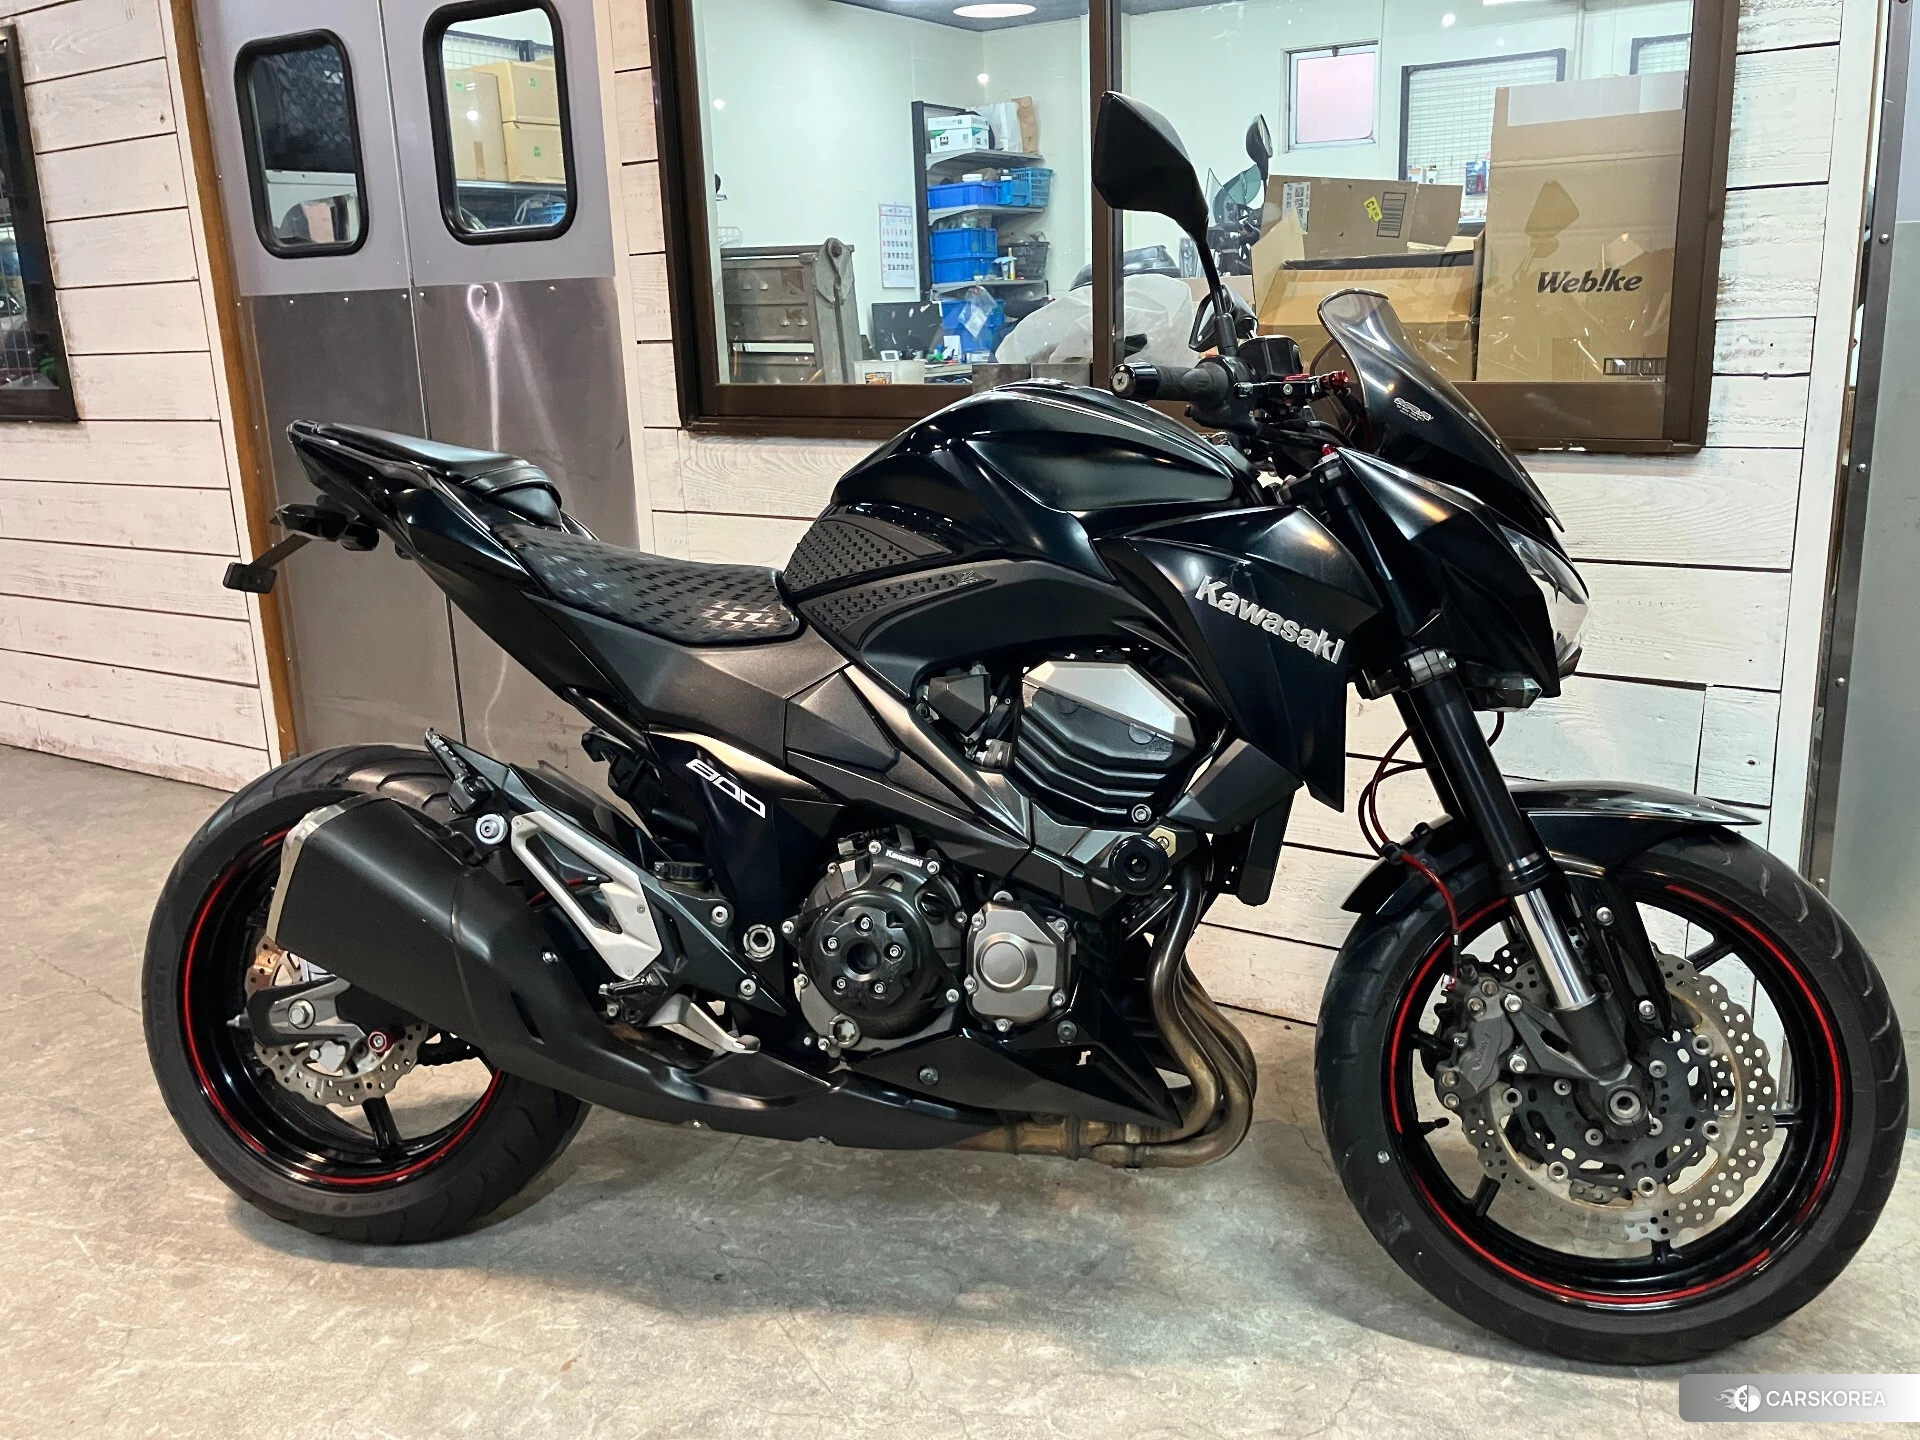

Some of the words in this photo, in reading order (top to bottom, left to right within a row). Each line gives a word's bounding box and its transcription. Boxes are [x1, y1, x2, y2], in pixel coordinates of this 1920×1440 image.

[1195, 574, 1346, 664] Kawasaki
[686, 758, 765, 818] 800
[886, 850, 923, 867] Kawasaki
